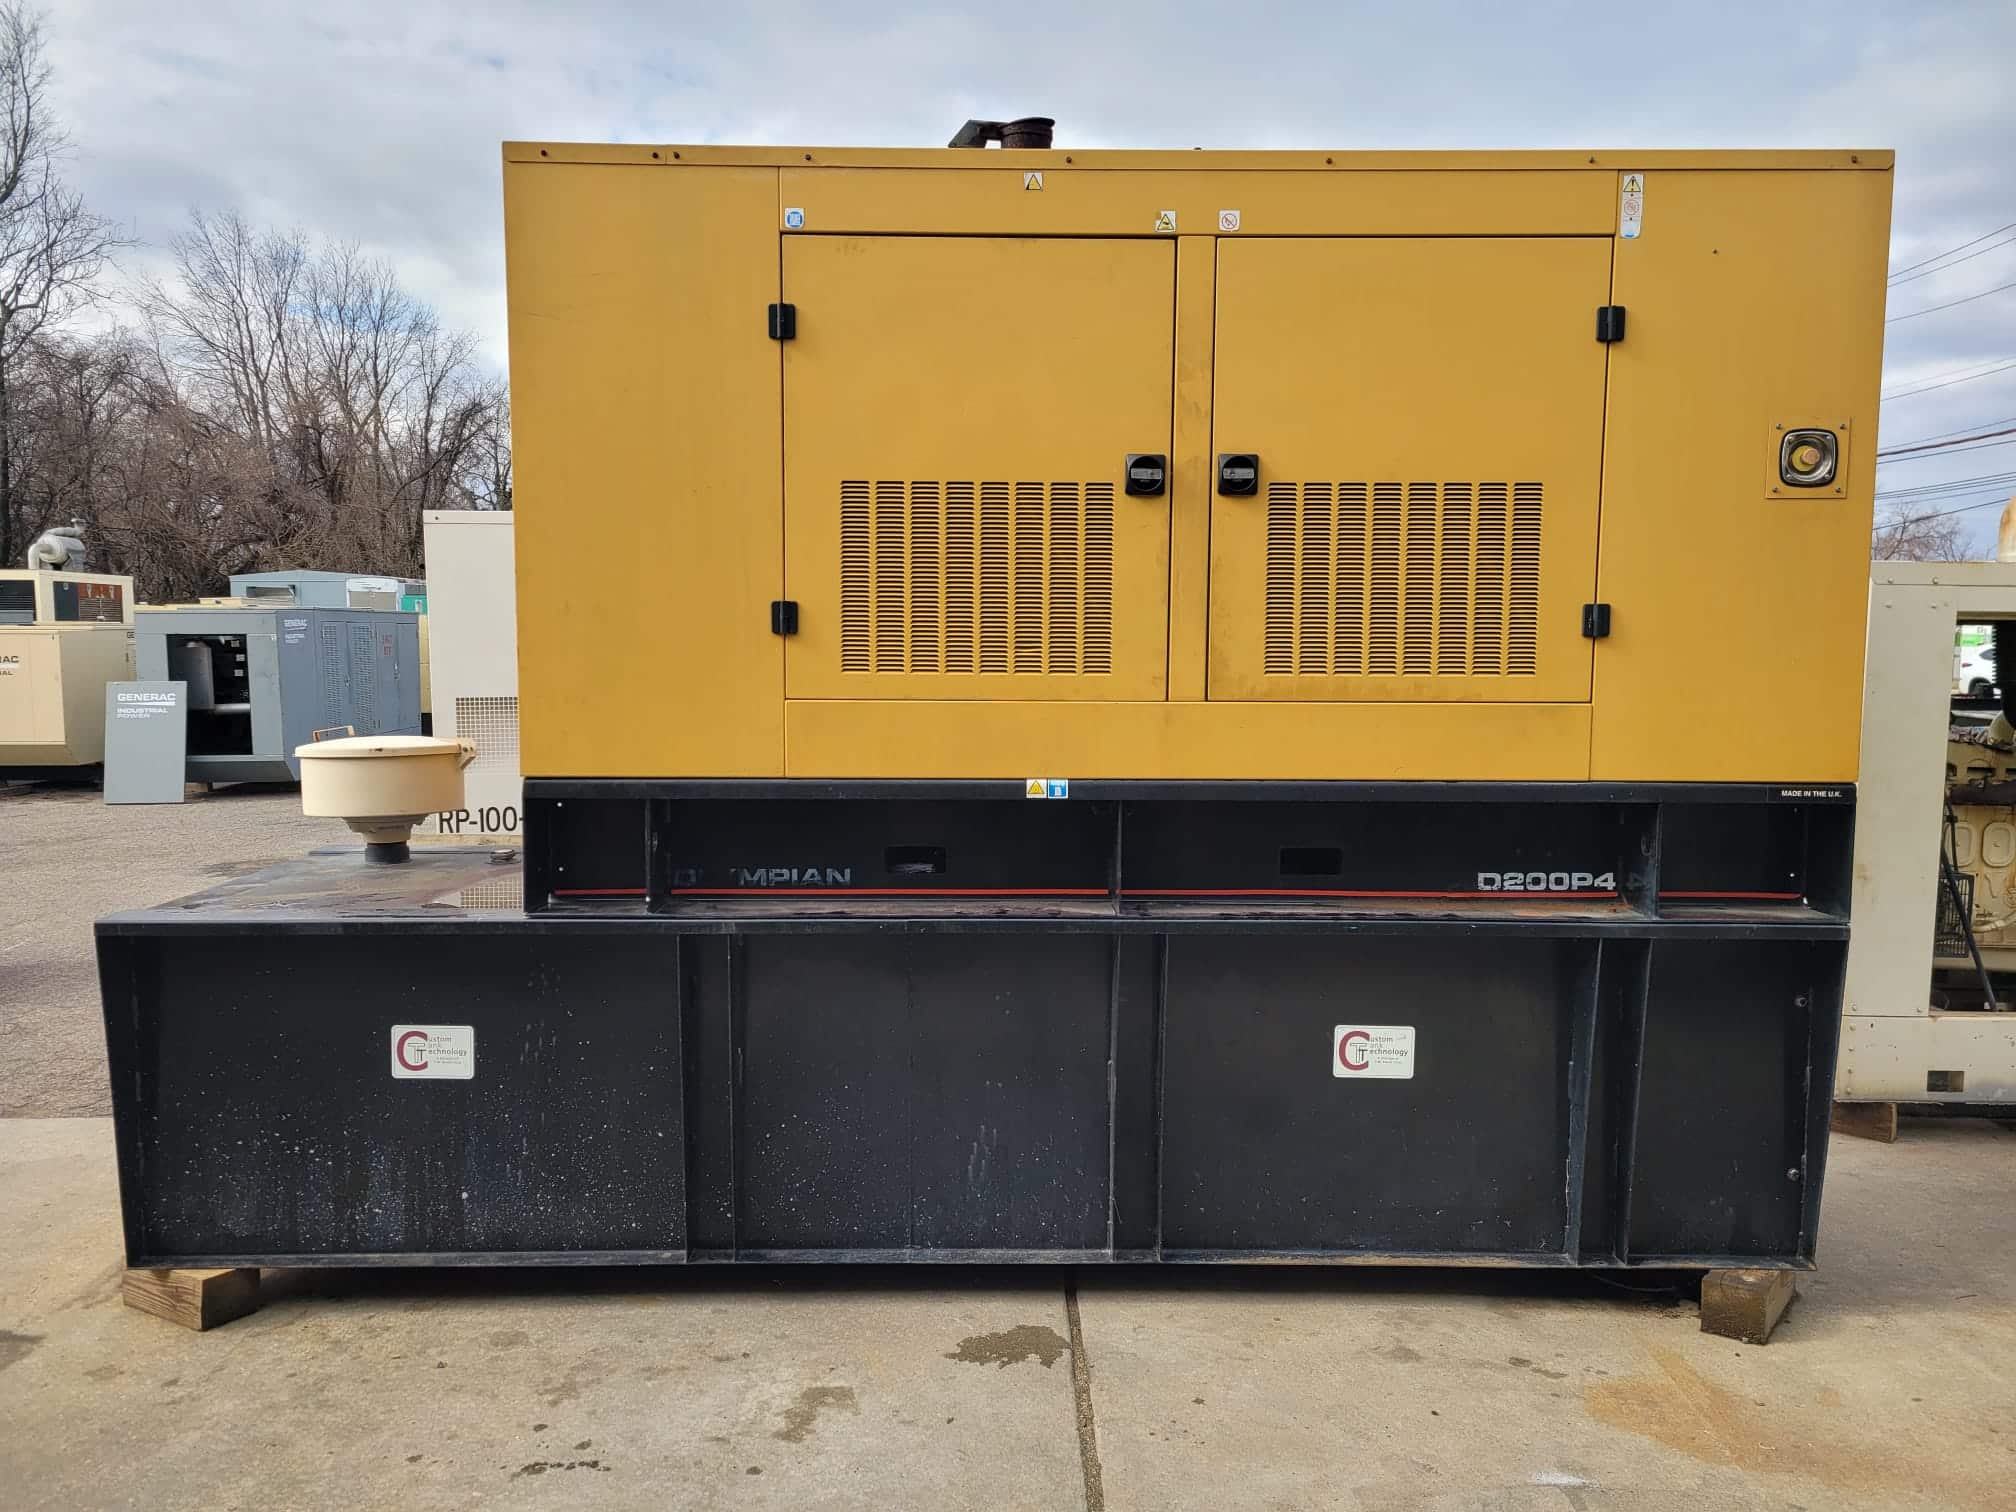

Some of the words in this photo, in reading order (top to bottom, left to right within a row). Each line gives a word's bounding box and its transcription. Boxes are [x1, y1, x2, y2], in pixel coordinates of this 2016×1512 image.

[117, 692, 176, 702] GENERAC
[1781, 789, 1802, 797] MADE
[1812, 790, 1827, 798] THE
[1477, 871, 1616, 891] D200P4
